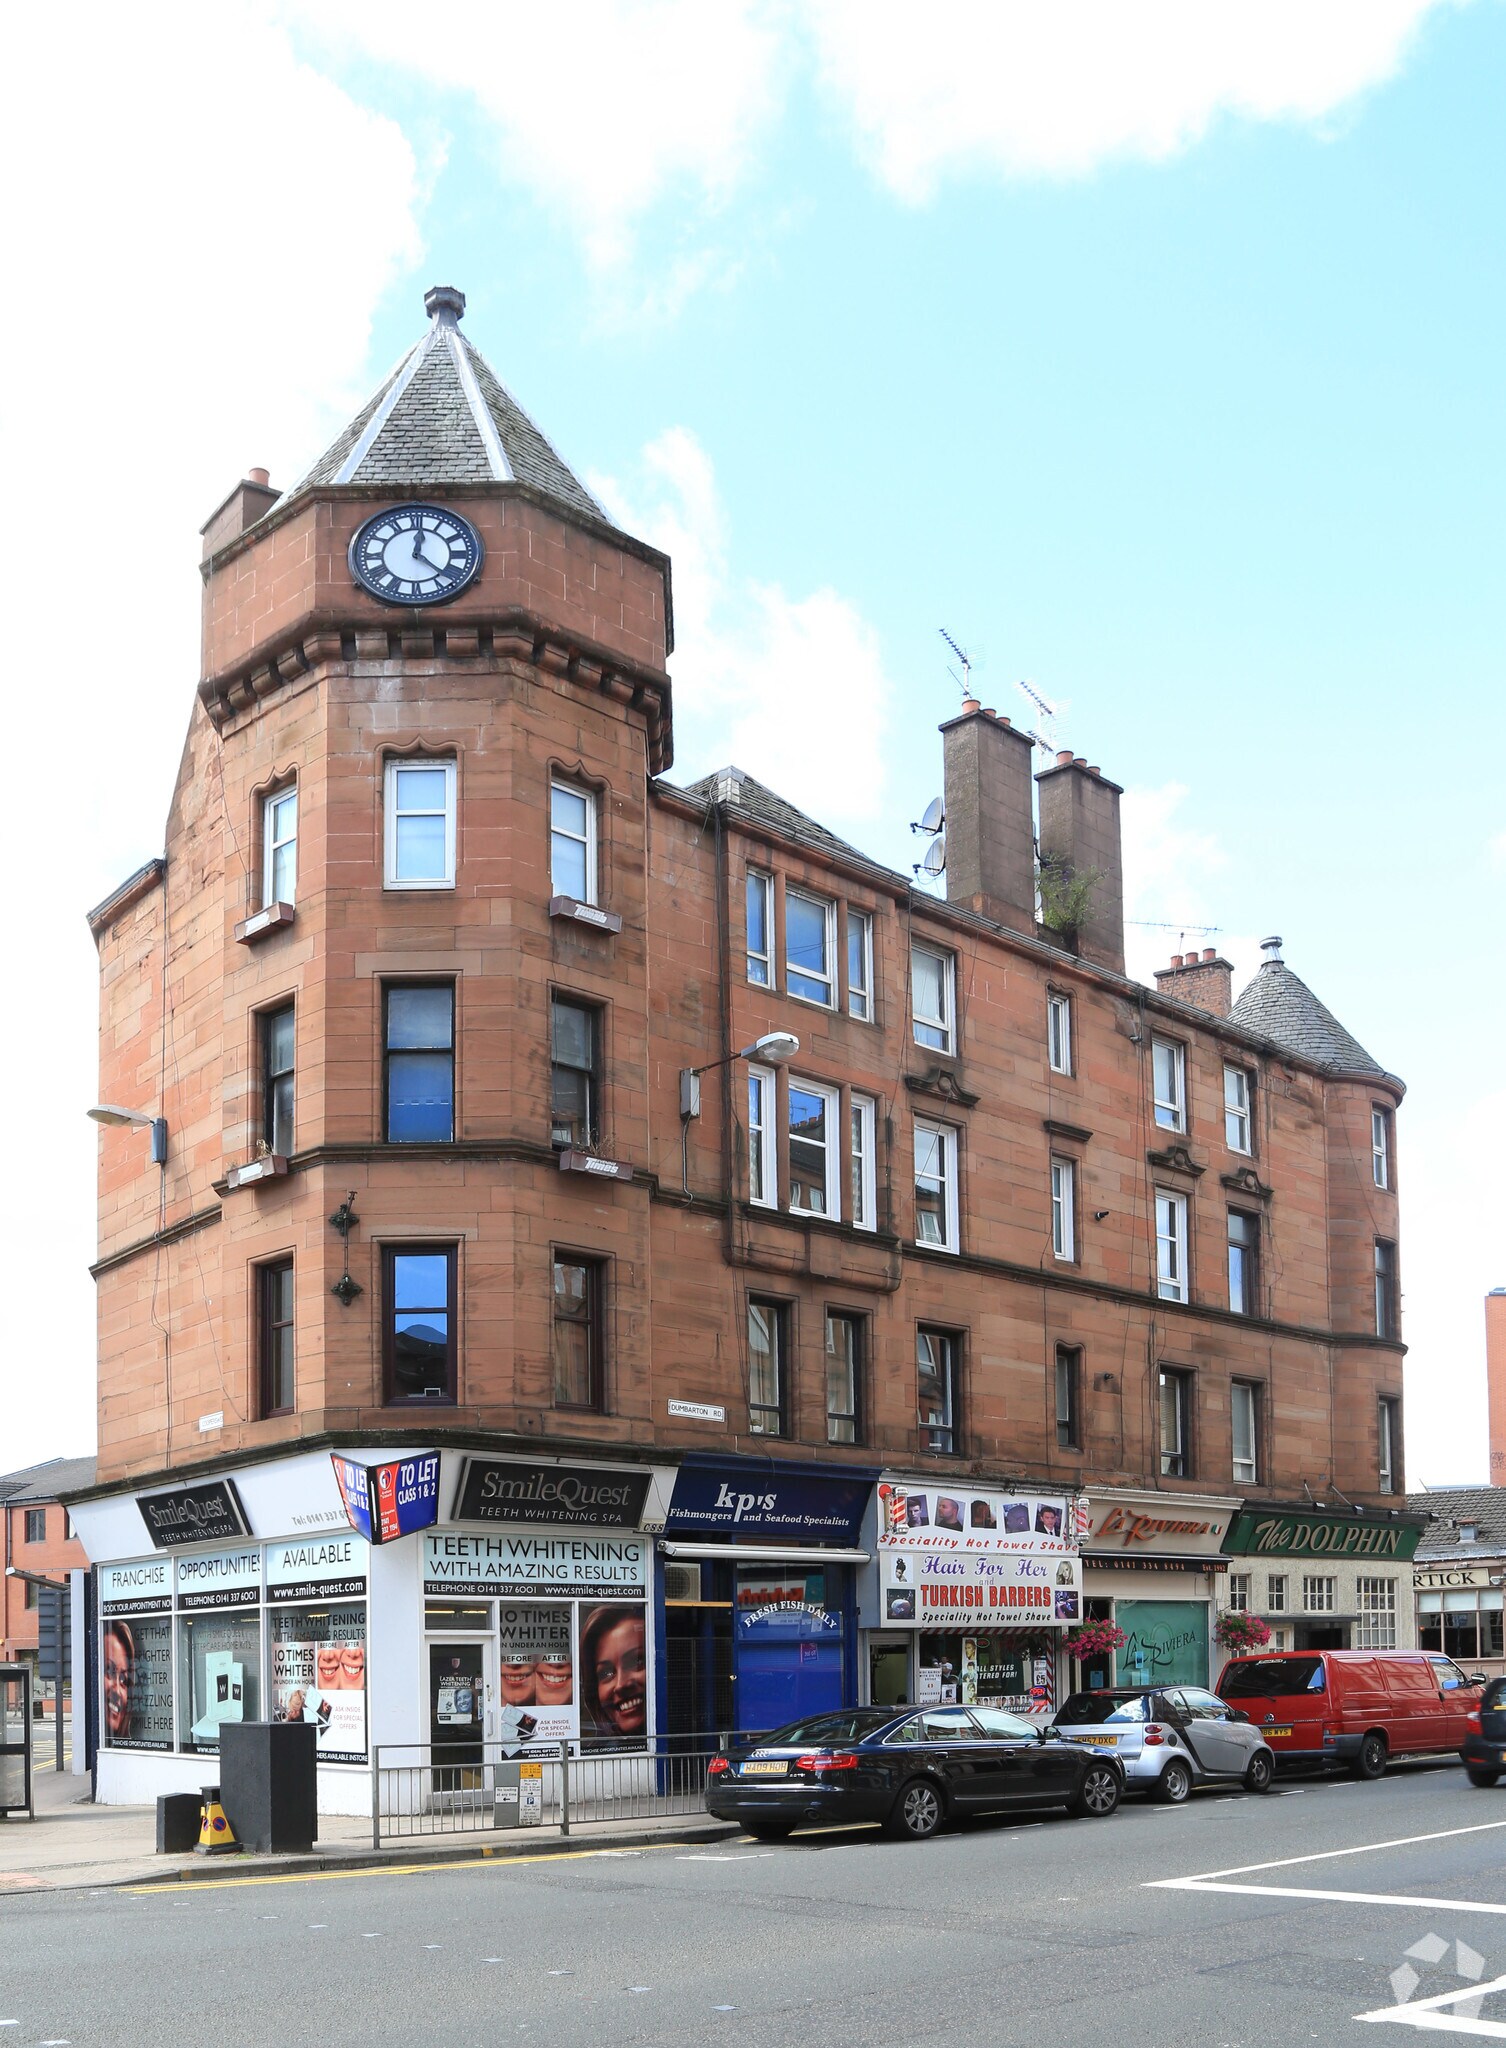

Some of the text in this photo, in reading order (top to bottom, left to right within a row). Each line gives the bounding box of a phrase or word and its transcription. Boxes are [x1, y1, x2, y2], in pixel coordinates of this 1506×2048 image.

[410, 516, 423, 528] XII
[671, 1404, 709, 1416] DUMBARTON
[345, 1465, 368, 1493] TO LET
[401, 1458, 438, 1487] TO LET
[398, 1487, 416, 1505] CLASS
[424, 1484, 429, 1497] &
[431, 1482, 435, 1496] 2
[481, 1471, 631, 1511] SmileQuest
[715, 1484, 777, 1522] kp's
[149, 1496, 227, 1527] SmileQuest
[292, 1509, 338, 1526] Tel: 0141 337
[479, 1506, 622, 1523] TEETH WHITENING SPA
[669, 1508, 849, 1526] Fishmongers and Seafood Specialists
[161, 1524, 233, 1542] TEETH WHITENING SPA
[1255, 1520, 1404, 1554] The DOLPHIN
[427, 1536, 639, 1562] TEETH WHITENING
[880, 1534, 1078, 1552] Speciality Hot Towel Shave
[112, 1543, 351, 1588] FRANCHISE OPPORTUNITIES AVAILABLE
[430, 1561, 637, 1581] WITH AMAZING RESULTS
[921, 1556, 1048, 1577] Hair For Her
[1085, 1560, 1158, 1570] TEL: 0141 334
[1214, 1564, 1226, 1572] 1992
[979, 1577, 994, 1586] and
[1413, 1572, 1476, 1588] RTICK
[273, 1581, 363, 1599] www.smile-quest.com
[426, 1584, 537, 1594] TELEPHONE 0141 337 6001
[544, 1585, 642, 1597] www.smile-quest.com
[921, 1584, 1051, 1607] TURKISH BARBERS
[104, 1599, 171, 1612] BOOK YOUR APPOINTMENT NO
[185, 1591, 257, 1606] TELEPHONE 0141 337 6001
[273, 1613, 365, 1628] TEETH WHITENING
[521, 1610, 571, 1623] TIMES
[744, 1601, 837, 1629] FRESH FISH DAILY
[922, 1612, 1051, 1623] Speciality Hot Towel Shave
[135, 1627, 170, 1640] GET THAT
[273, 1629, 365, 1642] WITH AMAZING RESULTS
[500, 1626, 569, 1639] WHITER
[274, 1649, 314, 1662] 10 TIMES
[542, 1654, 567, 1662] AFTER
[274, 1664, 314, 1677] WHITER
[990, 1664, 1014, 1672] STYLES
[1036, 1674, 1045, 1685] £5
[131, 1717, 173, 1731] SMILE HERE
[327, 1753, 368, 1762] AVAILABLE INSTORE
